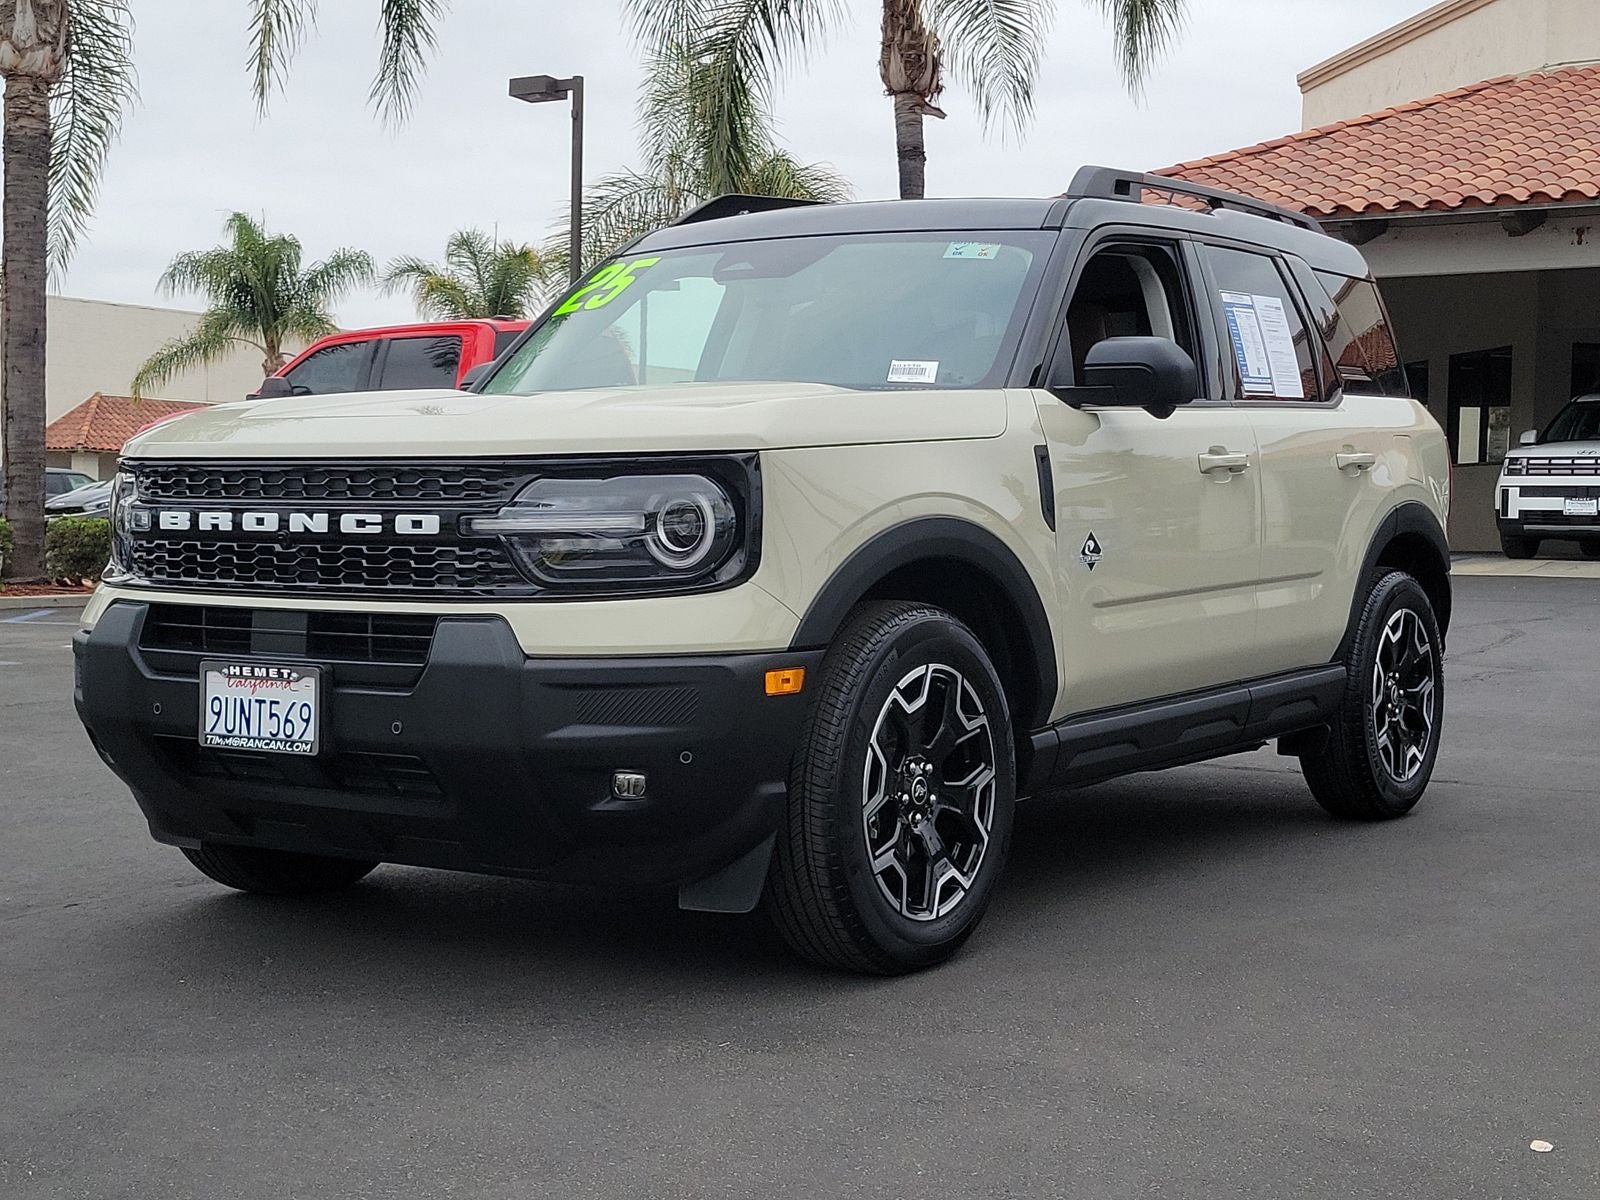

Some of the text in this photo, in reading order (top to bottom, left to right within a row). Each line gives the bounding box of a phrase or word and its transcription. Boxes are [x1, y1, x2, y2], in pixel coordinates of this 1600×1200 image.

[551, 256, 662, 317] 25
[159, 511, 440, 534] BRONCO
[229, 666, 291, 679] HEMET
[210, 696, 312, 739] 9UNT569
